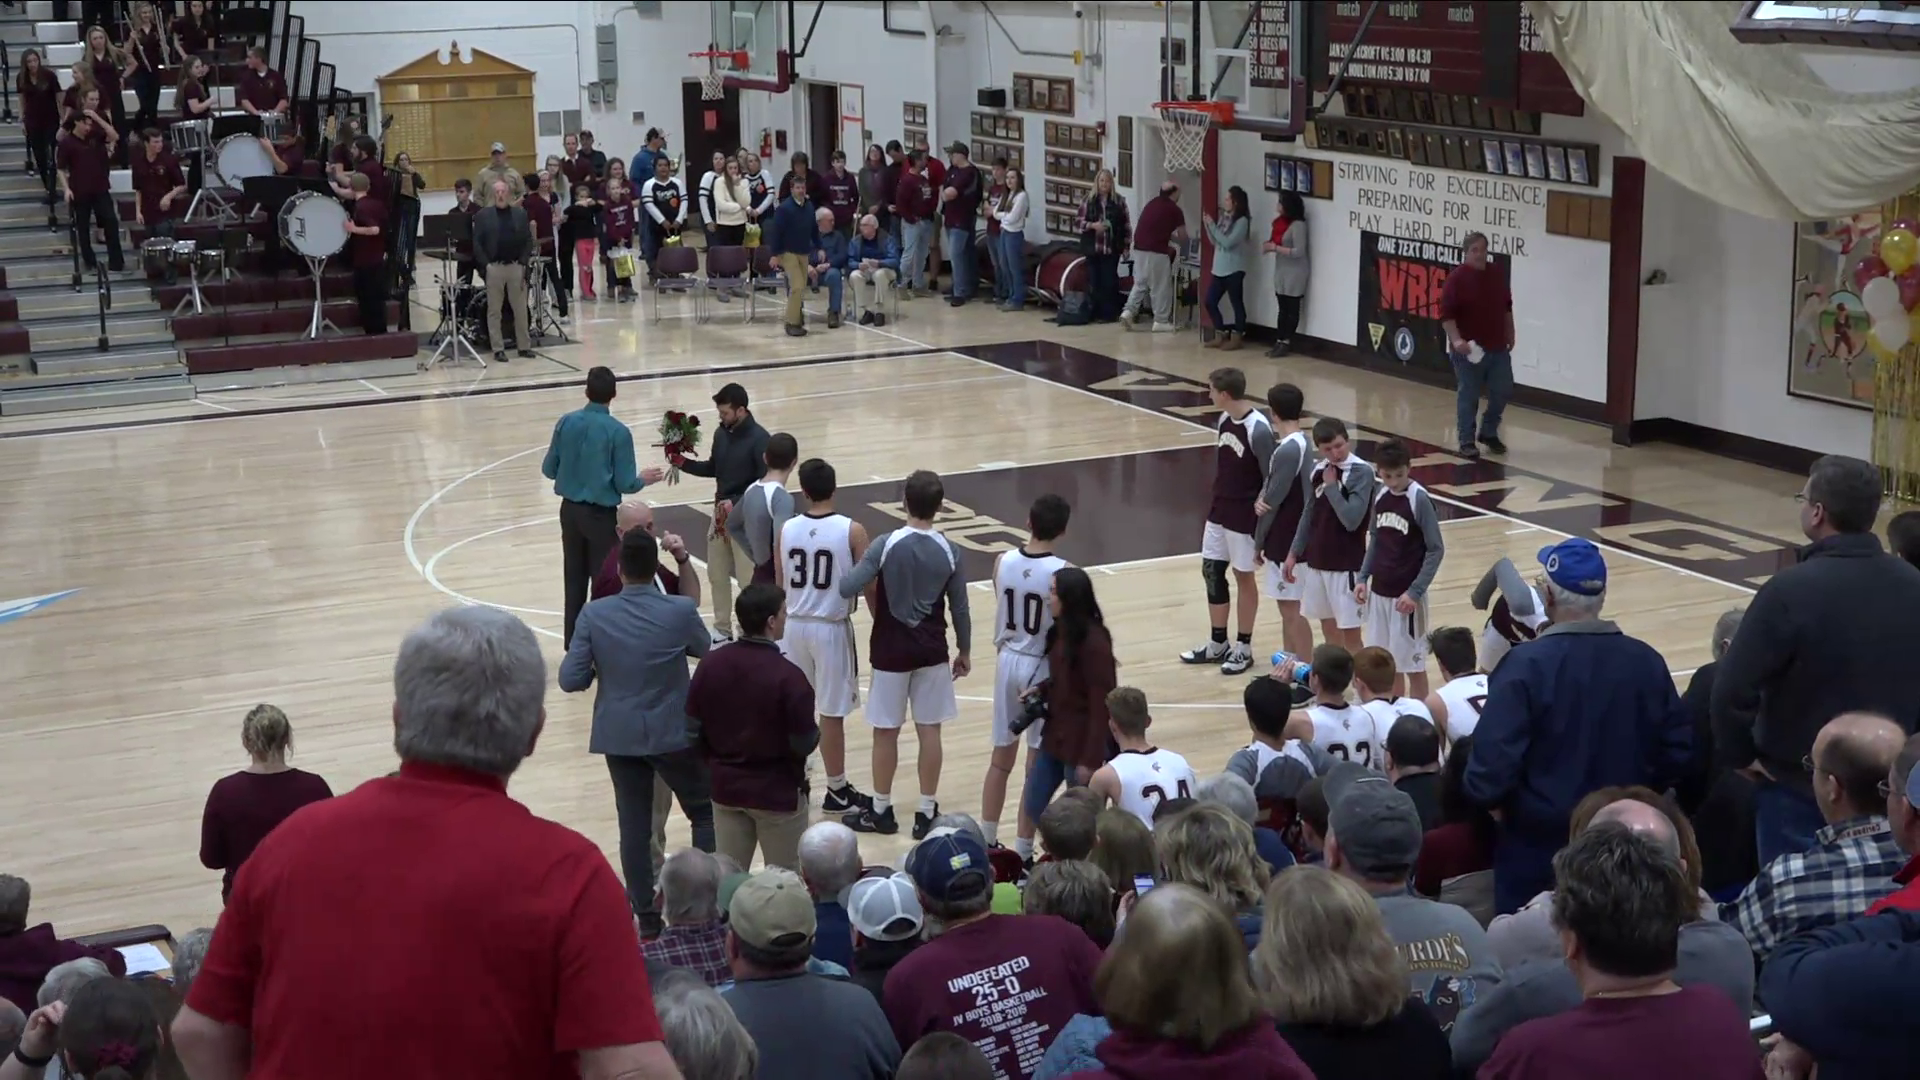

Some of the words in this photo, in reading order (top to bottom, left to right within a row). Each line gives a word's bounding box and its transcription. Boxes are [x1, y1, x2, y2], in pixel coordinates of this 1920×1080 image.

[1336, 2, 1360, 16] match
[1447, 5, 1474, 22] match
[1338, 161, 1398, 187] STRIVING
[1409, 170, 1436, 192] FOR
[1447, 175, 1547, 209] EXCELLENCE,
[1358, 188, 1434, 217] PREPARING
[1443, 201, 1471, 222] FOR
[1484, 205, 1522, 230] LIFE.
[1350, 211, 1383, 233] PLAY
[1394, 218, 1435, 243] HARD.
[1492, 233, 1529, 258] FAIR.
[1377, 235, 1397, 253] ONE
[1397, 239, 1421, 260] TEXT
[1422, 244, 1437, 261] OR
[1437, 246, 1461, 266] CALL
[1377, 257, 1447, 321] WRE
[788, 547, 834, 590] 30
[1004, 587, 1044, 637] 10
[947, 955, 1031, 994] UNDEFEATED
[971, 977, 1021, 1007] 25-0
[953, 1014, 964, 1027] JV
[964, 1004, 992, 1022] BOYS
[991, 985, 1048, 1014] BASKETBALL
[980, 1003, 1028, 1028] 2018-2019
